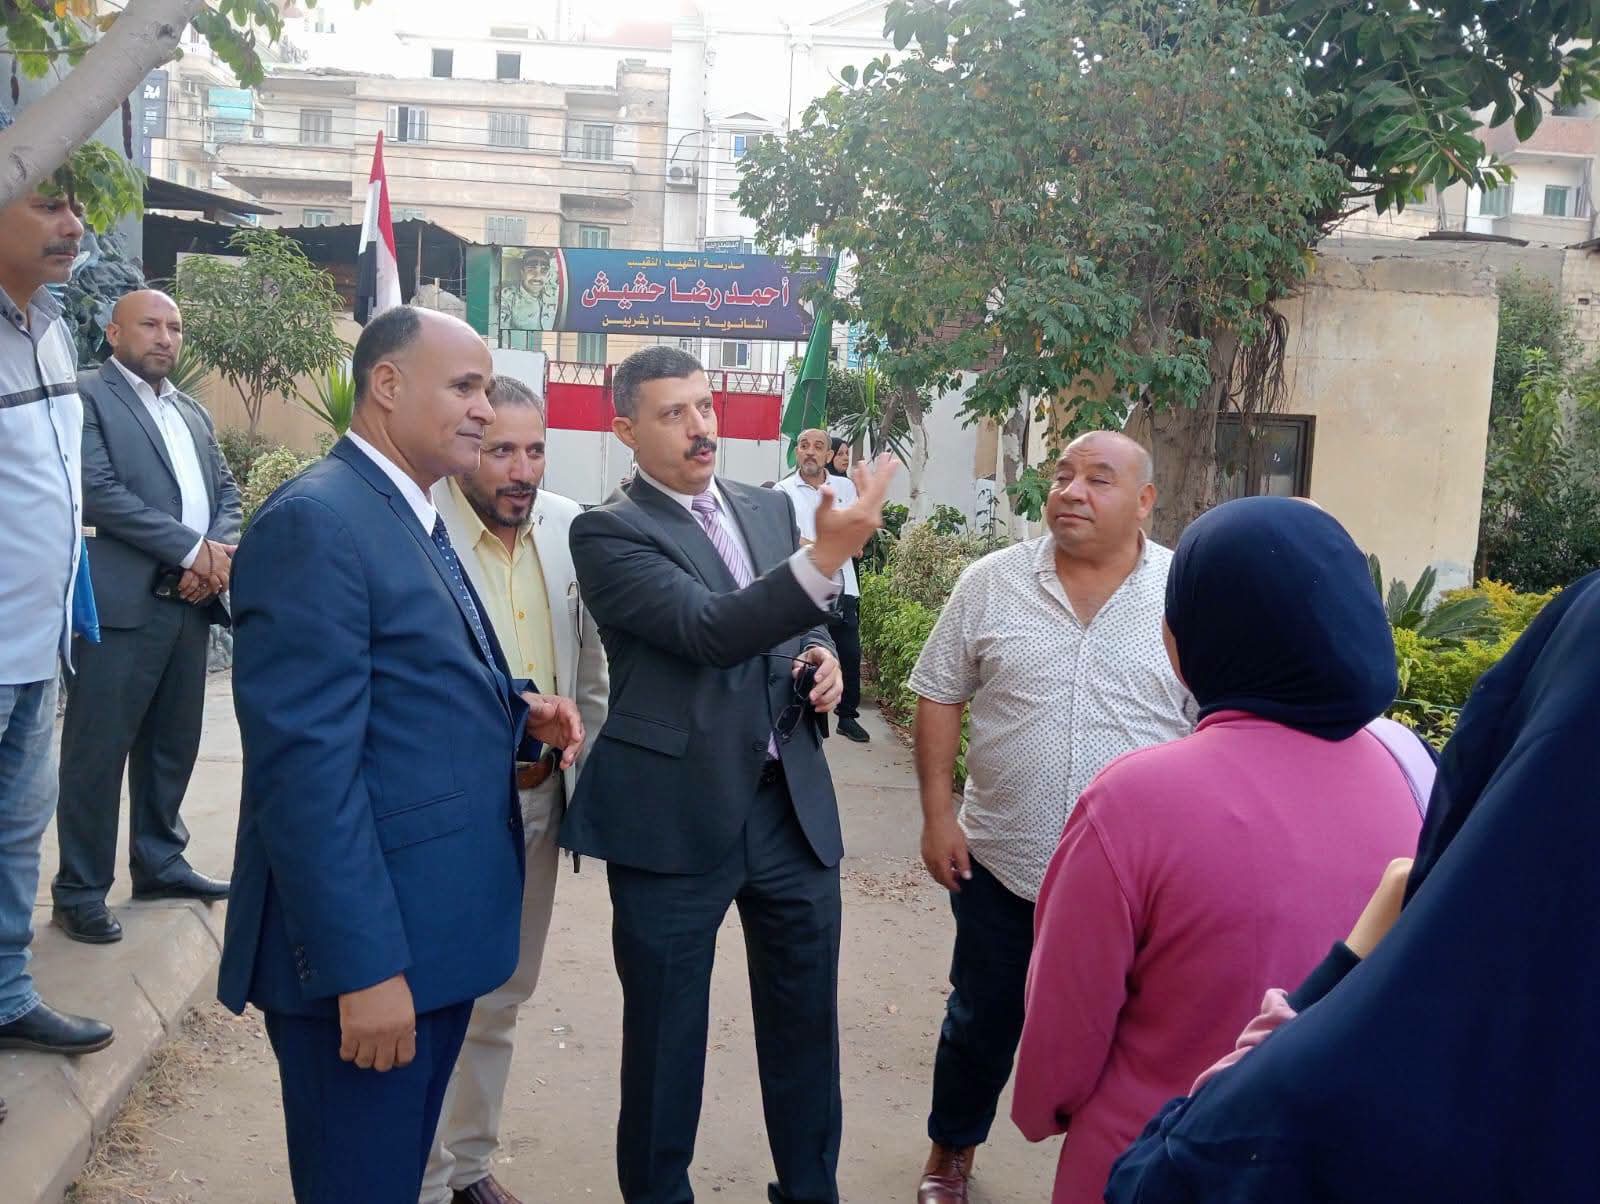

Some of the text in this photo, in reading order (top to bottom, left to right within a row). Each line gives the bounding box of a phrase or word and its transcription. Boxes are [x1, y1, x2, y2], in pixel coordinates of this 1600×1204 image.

[627, 256, 745, 271] مدرسة الشهيد النقيب
[581, 271, 790, 310] أحمد رضا حشيش
[601, 314, 768, 329] الثانوية بنات بشربين
